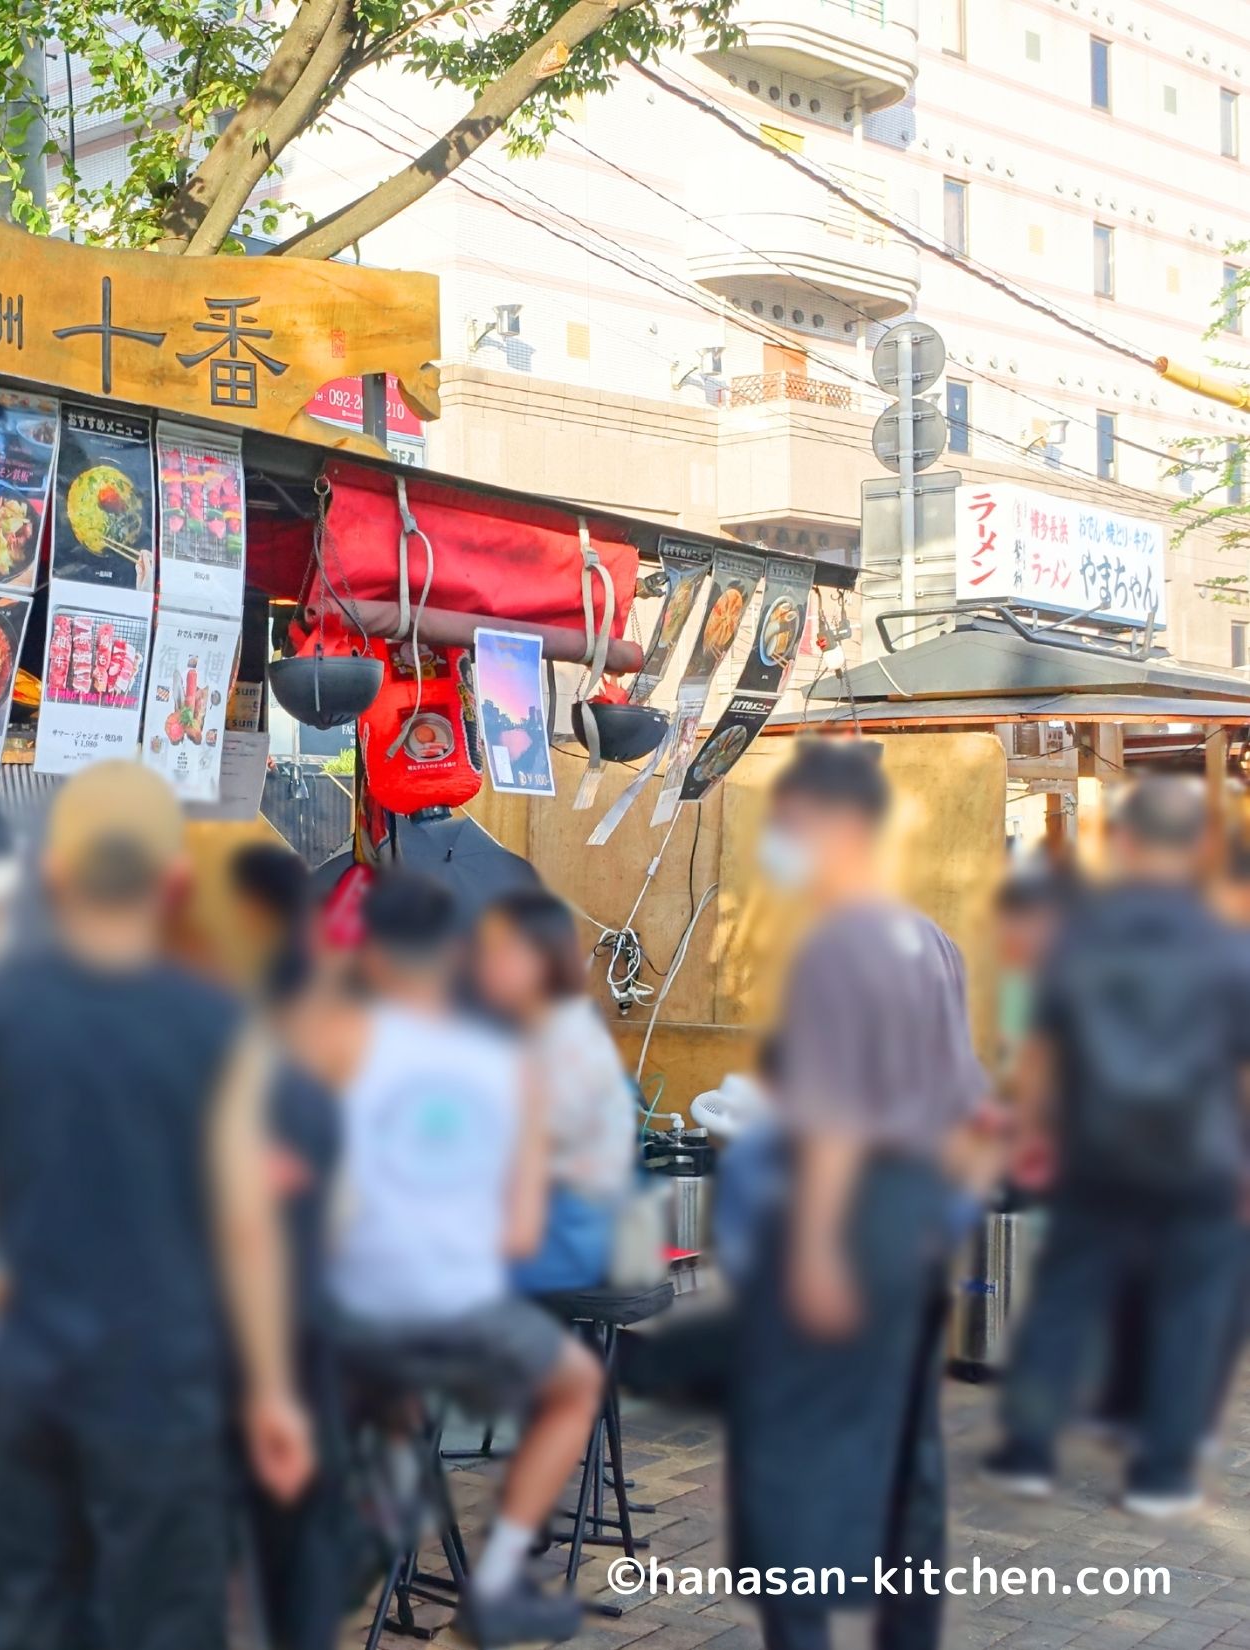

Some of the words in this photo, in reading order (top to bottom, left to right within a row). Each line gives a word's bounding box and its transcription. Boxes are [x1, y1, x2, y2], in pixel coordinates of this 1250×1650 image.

[67, 412, 143, 437] おすすめメニュー
[968, 492, 998, 586] ラーメン
[1032, 552, 1073, 592] ラーメン
[1079, 548, 1160, 612] やまちゃん
